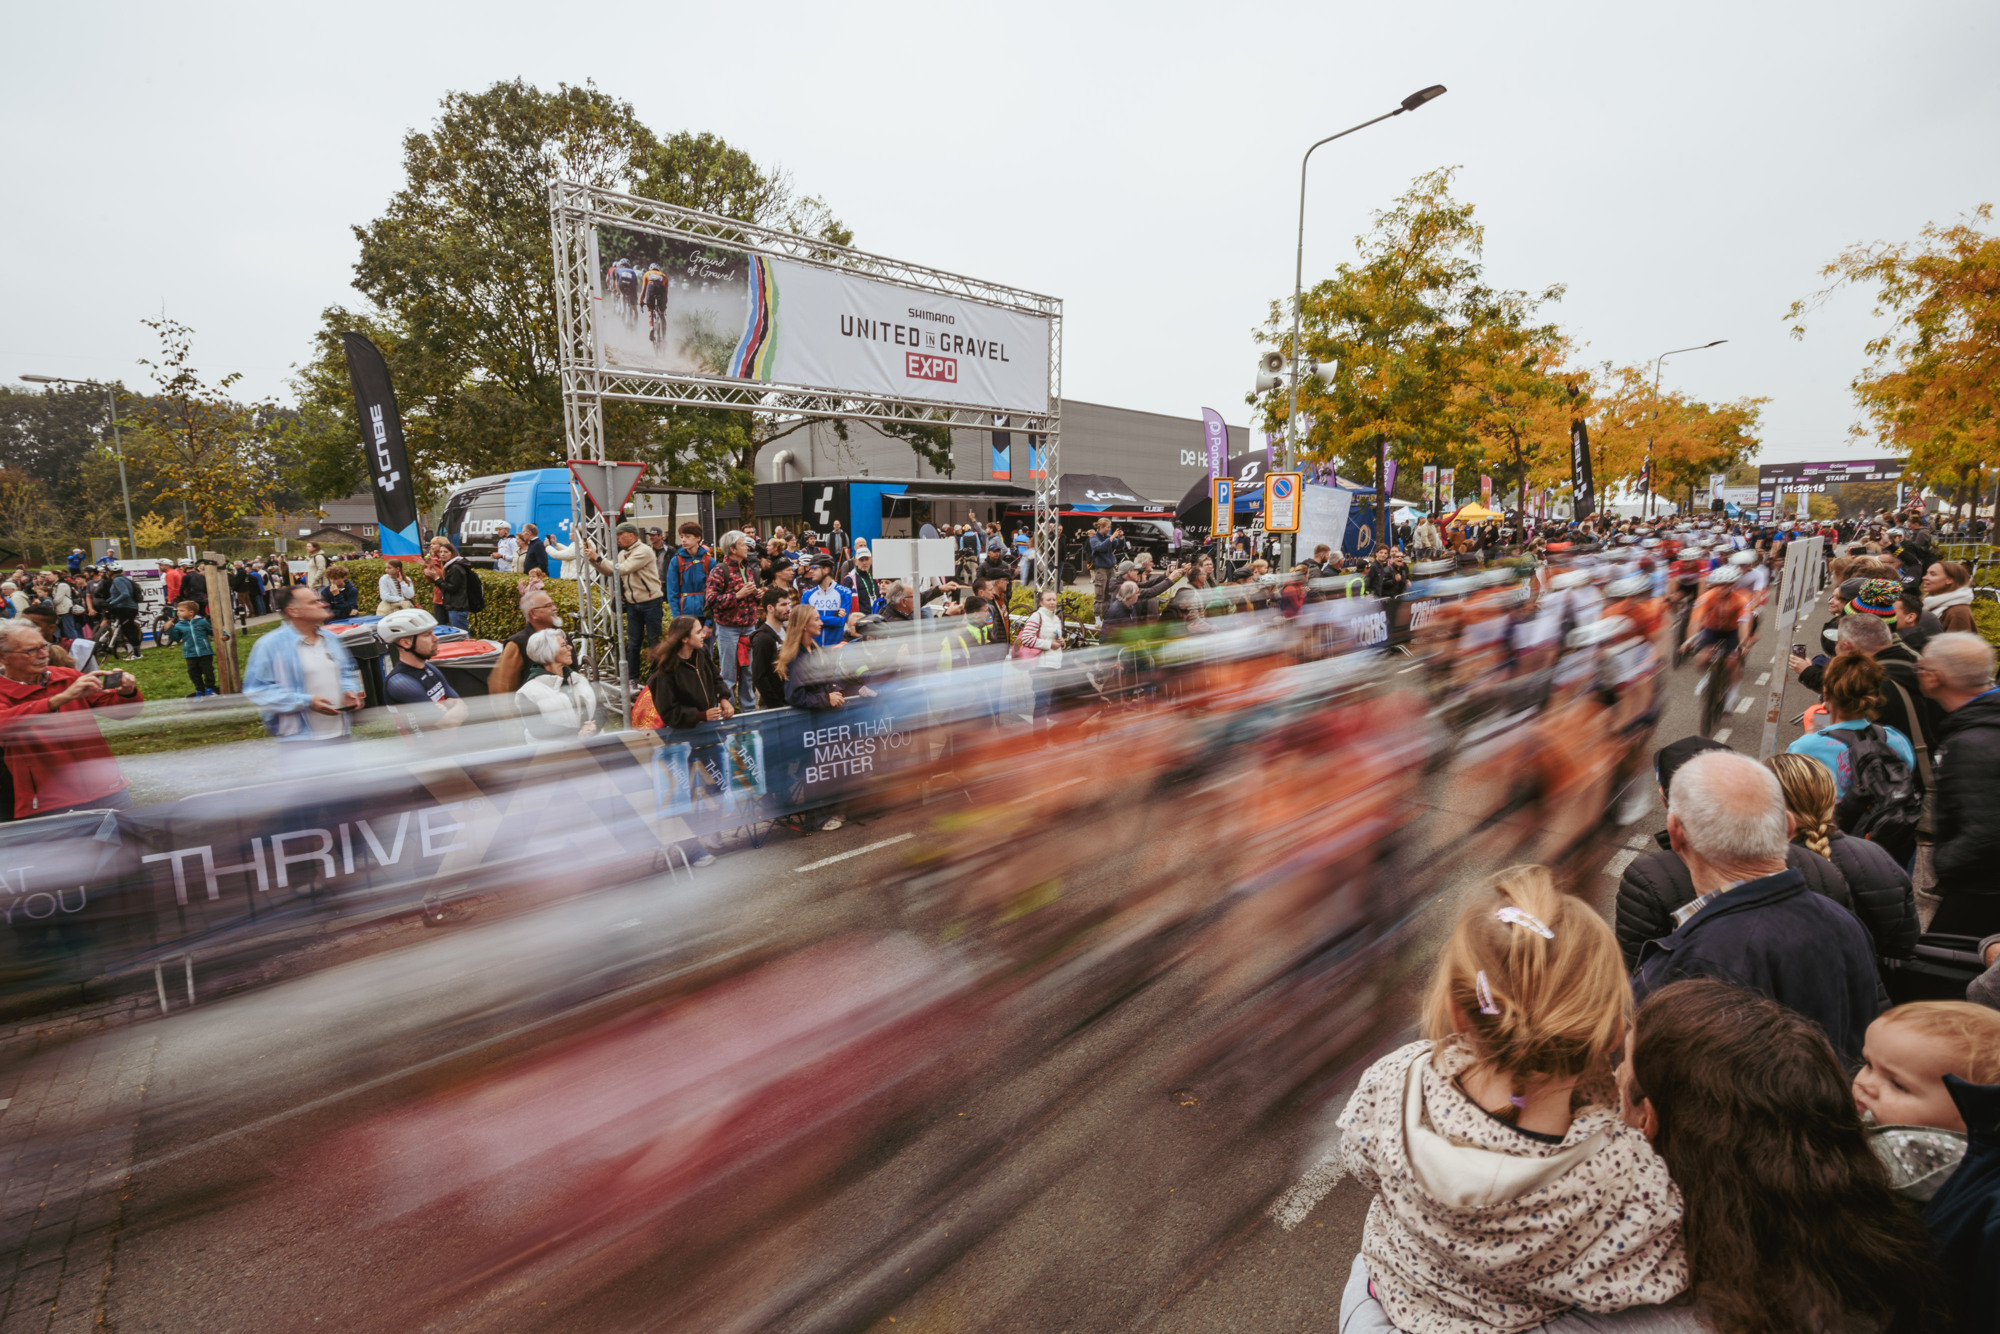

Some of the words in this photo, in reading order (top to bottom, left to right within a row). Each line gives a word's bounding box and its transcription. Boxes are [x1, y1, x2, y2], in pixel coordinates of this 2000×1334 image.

[689, 250, 727, 267] Ground
[687, 264, 698, 277] of
[699, 264, 735, 281] Gravel
[908, 308, 955, 325] SHIMANO
[841, 314, 920, 347] UNITED
[925, 334, 936, 346] IN
[940, 332, 1010, 363] GRAVEL
[908, 355, 956, 380] EXPO
[369, 403, 392, 472] CUBE
[1180, 448, 1196, 466] De
[1782, 483, 1826, 493] 11:20:15
[1825, 474, 1850, 482] START
[1143, 505, 1165, 513] CUBE
[1185, 525, 1196, 533] NO
[803, 724, 850, 748] BEER
[854, 716, 896, 738] THAT
[814, 737, 876, 764] MAKES
[879, 729, 912, 751] YOU
[736, 744, 762, 784] THRIVE
[805, 755, 873, 784] BETTER
[141, 801, 467, 906] THRIVE
